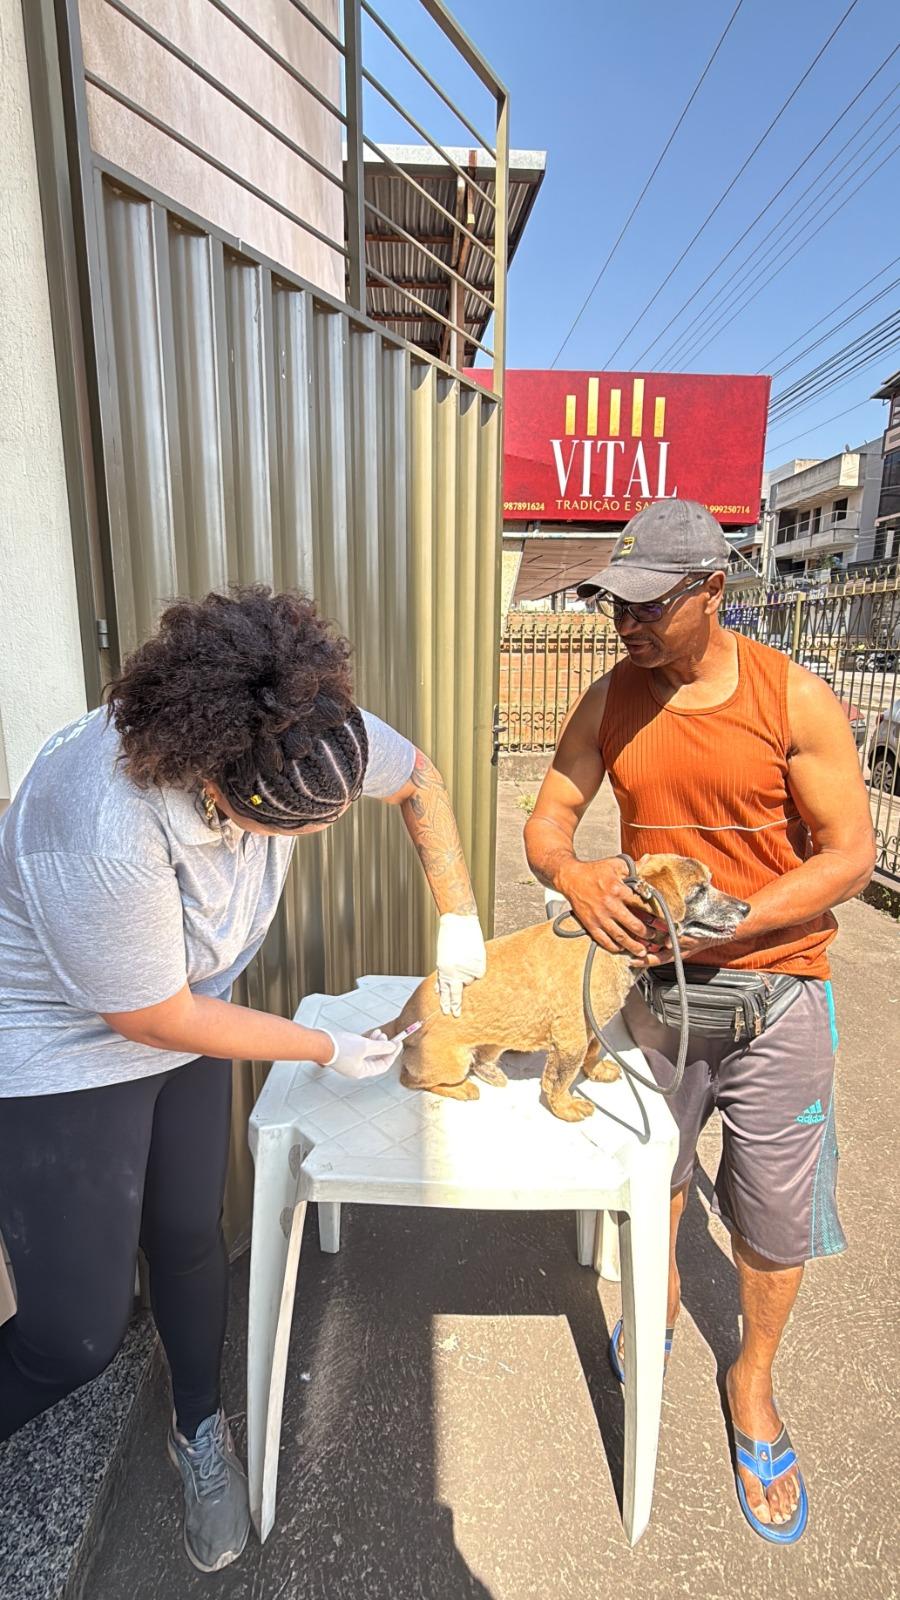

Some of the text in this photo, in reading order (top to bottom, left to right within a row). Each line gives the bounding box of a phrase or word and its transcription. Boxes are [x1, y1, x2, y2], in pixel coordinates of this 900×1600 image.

[550, 439, 678, 498] VITAL
[556, 499, 656, 512] TRADIÇÃO E SA
